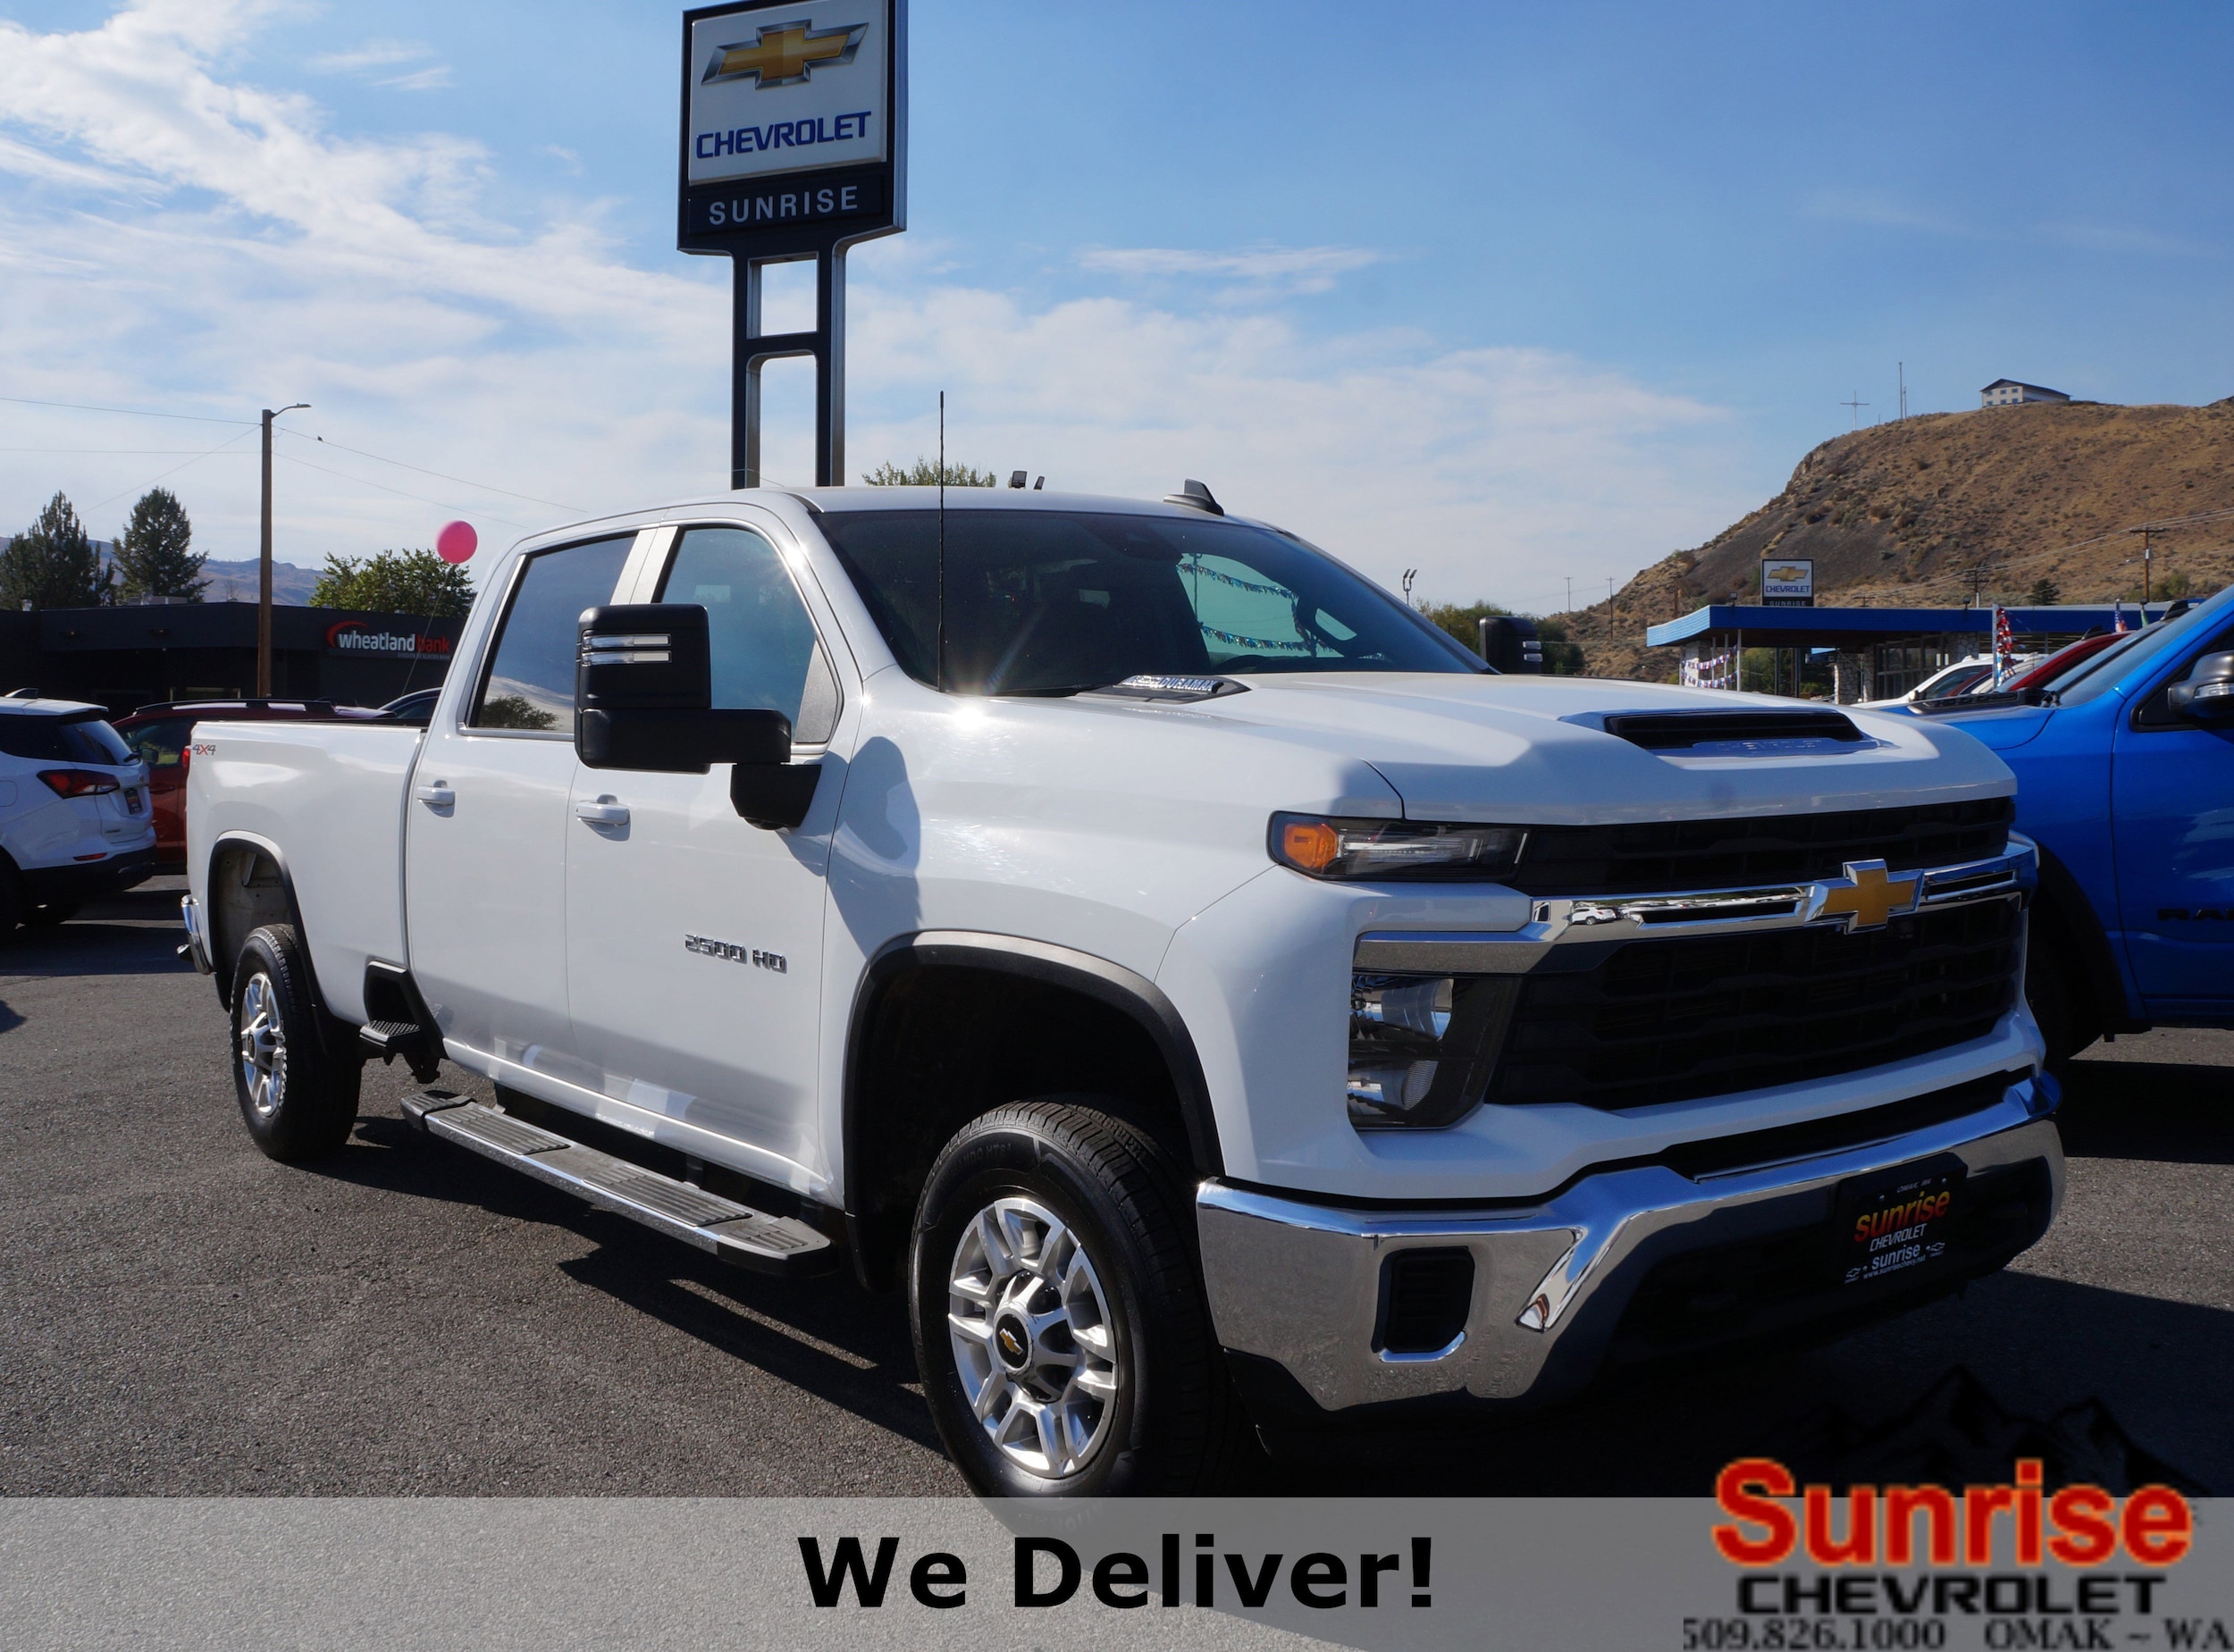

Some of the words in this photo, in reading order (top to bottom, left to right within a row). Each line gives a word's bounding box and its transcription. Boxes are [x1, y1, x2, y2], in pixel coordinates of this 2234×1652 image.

[696, 111, 872, 159] CHEVROLET
[709, 185, 858, 225] SUNRISE
[1766, 585, 1810, 593] CHEVROLET
[338, 630, 416, 652] wheatland
[416, 634, 450, 654] bank
[684, 934, 747, 965] 2500
[752, 949, 787, 974] HD
[1853, 1191, 1952, 1243] sunrise
[1869, 1222, 1927, 1253] CHEVROLET
[1871, 1244, 1921, 1271] sunrise
